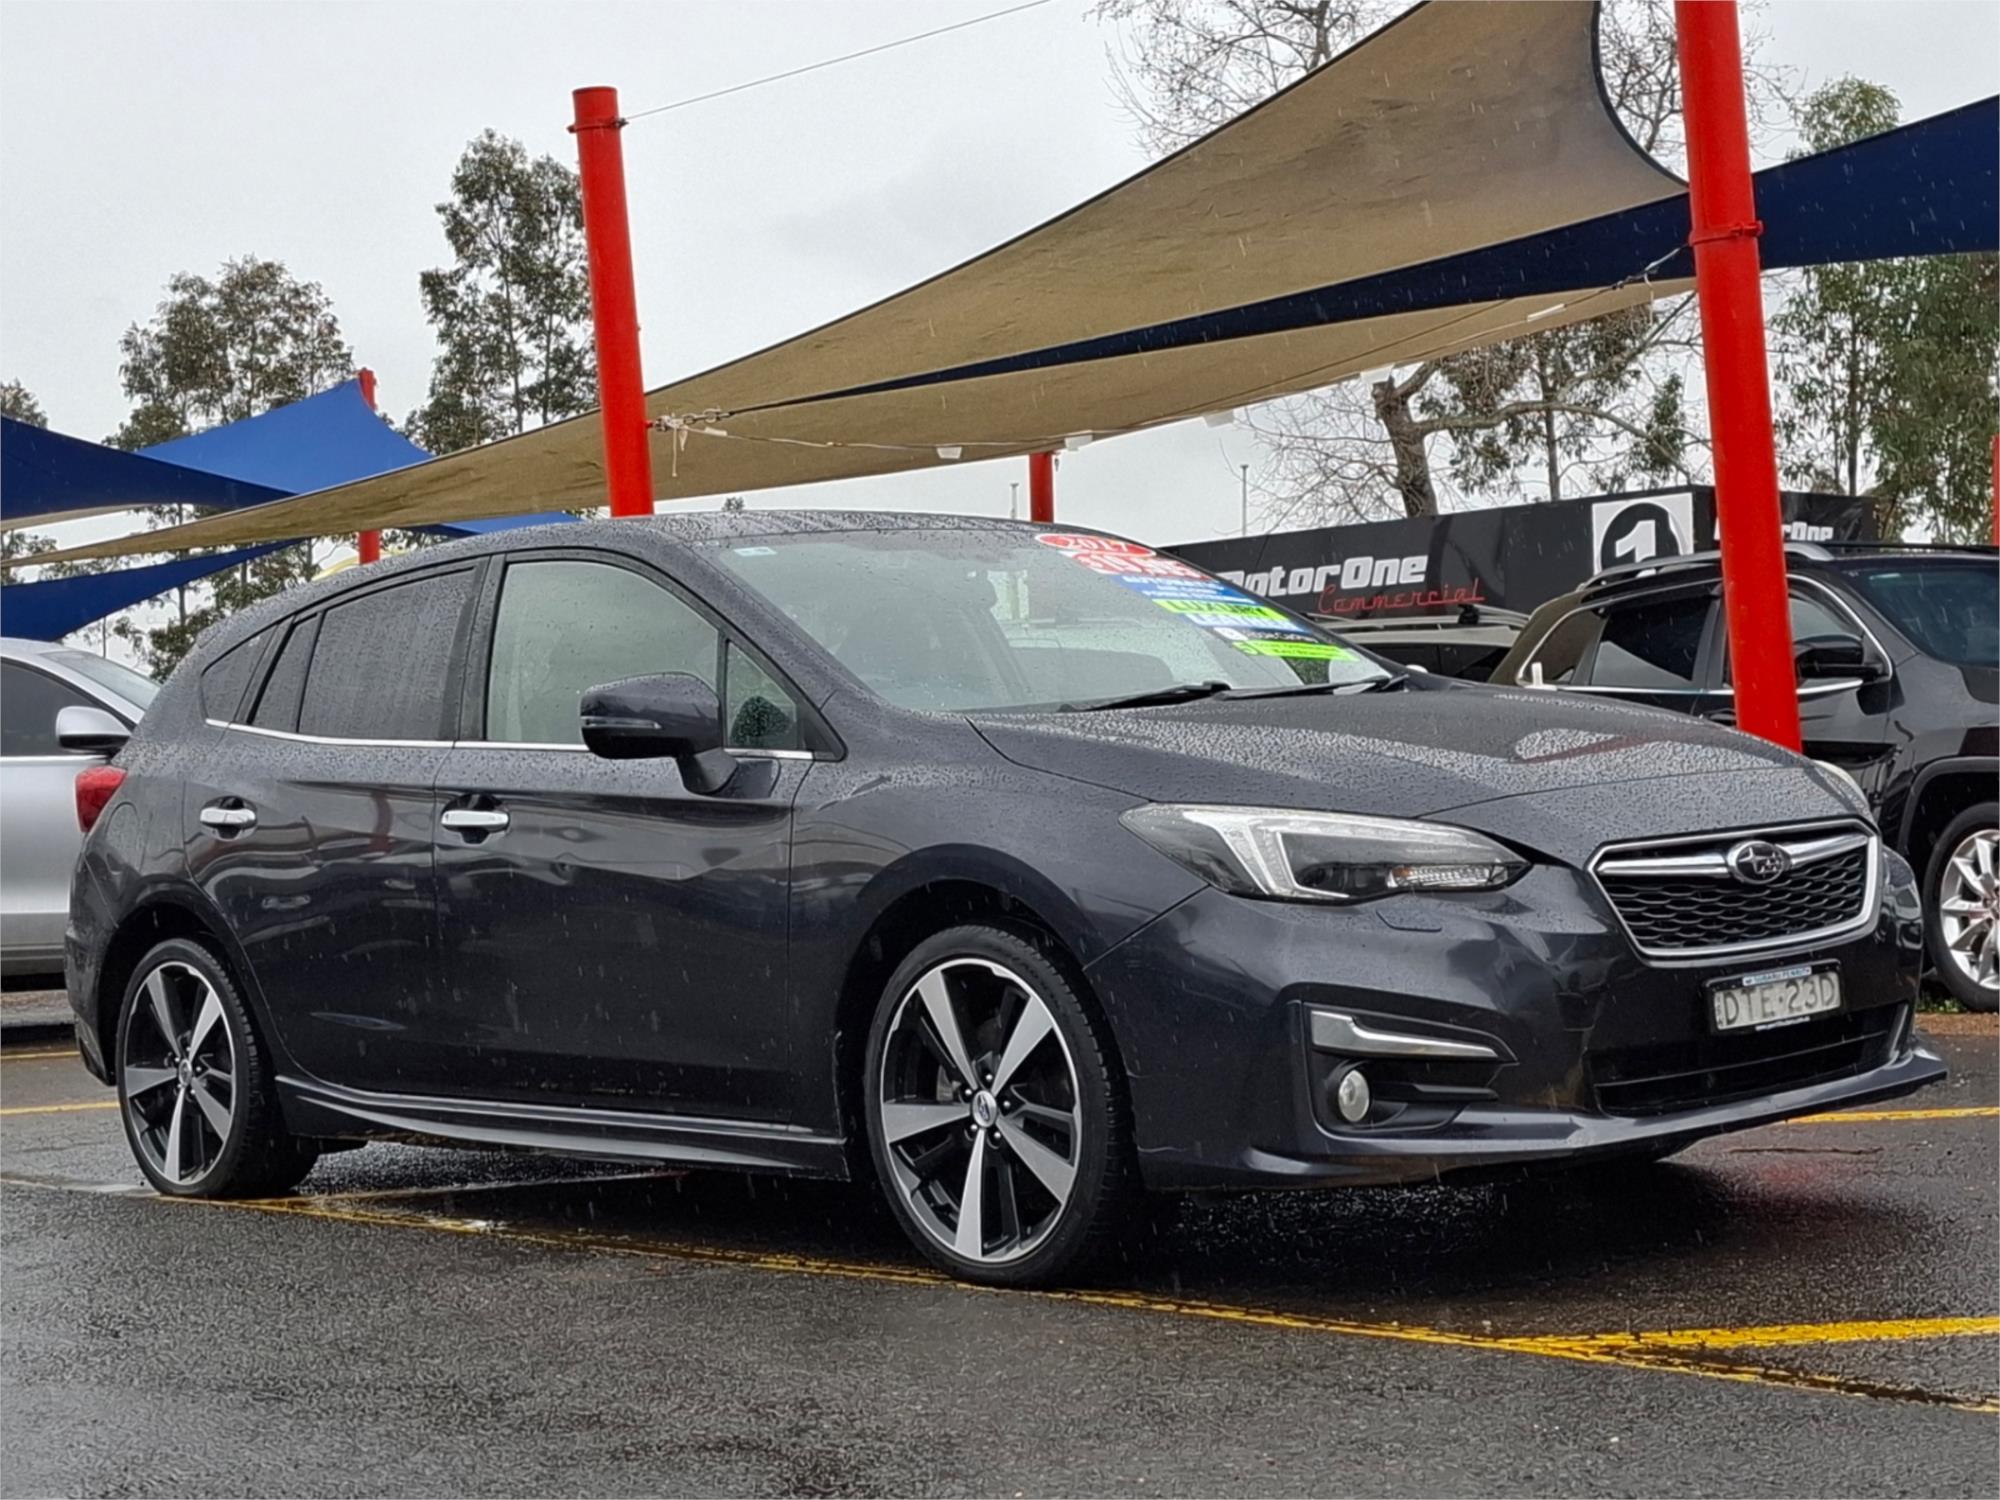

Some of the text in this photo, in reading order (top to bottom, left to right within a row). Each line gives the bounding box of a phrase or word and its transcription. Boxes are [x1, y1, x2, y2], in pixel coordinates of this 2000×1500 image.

[1063, 536, 1130, 552] 2017
[1317, 577, 1486, 613] Commercial
[1165, 599, 1269, 616] LUXURY
